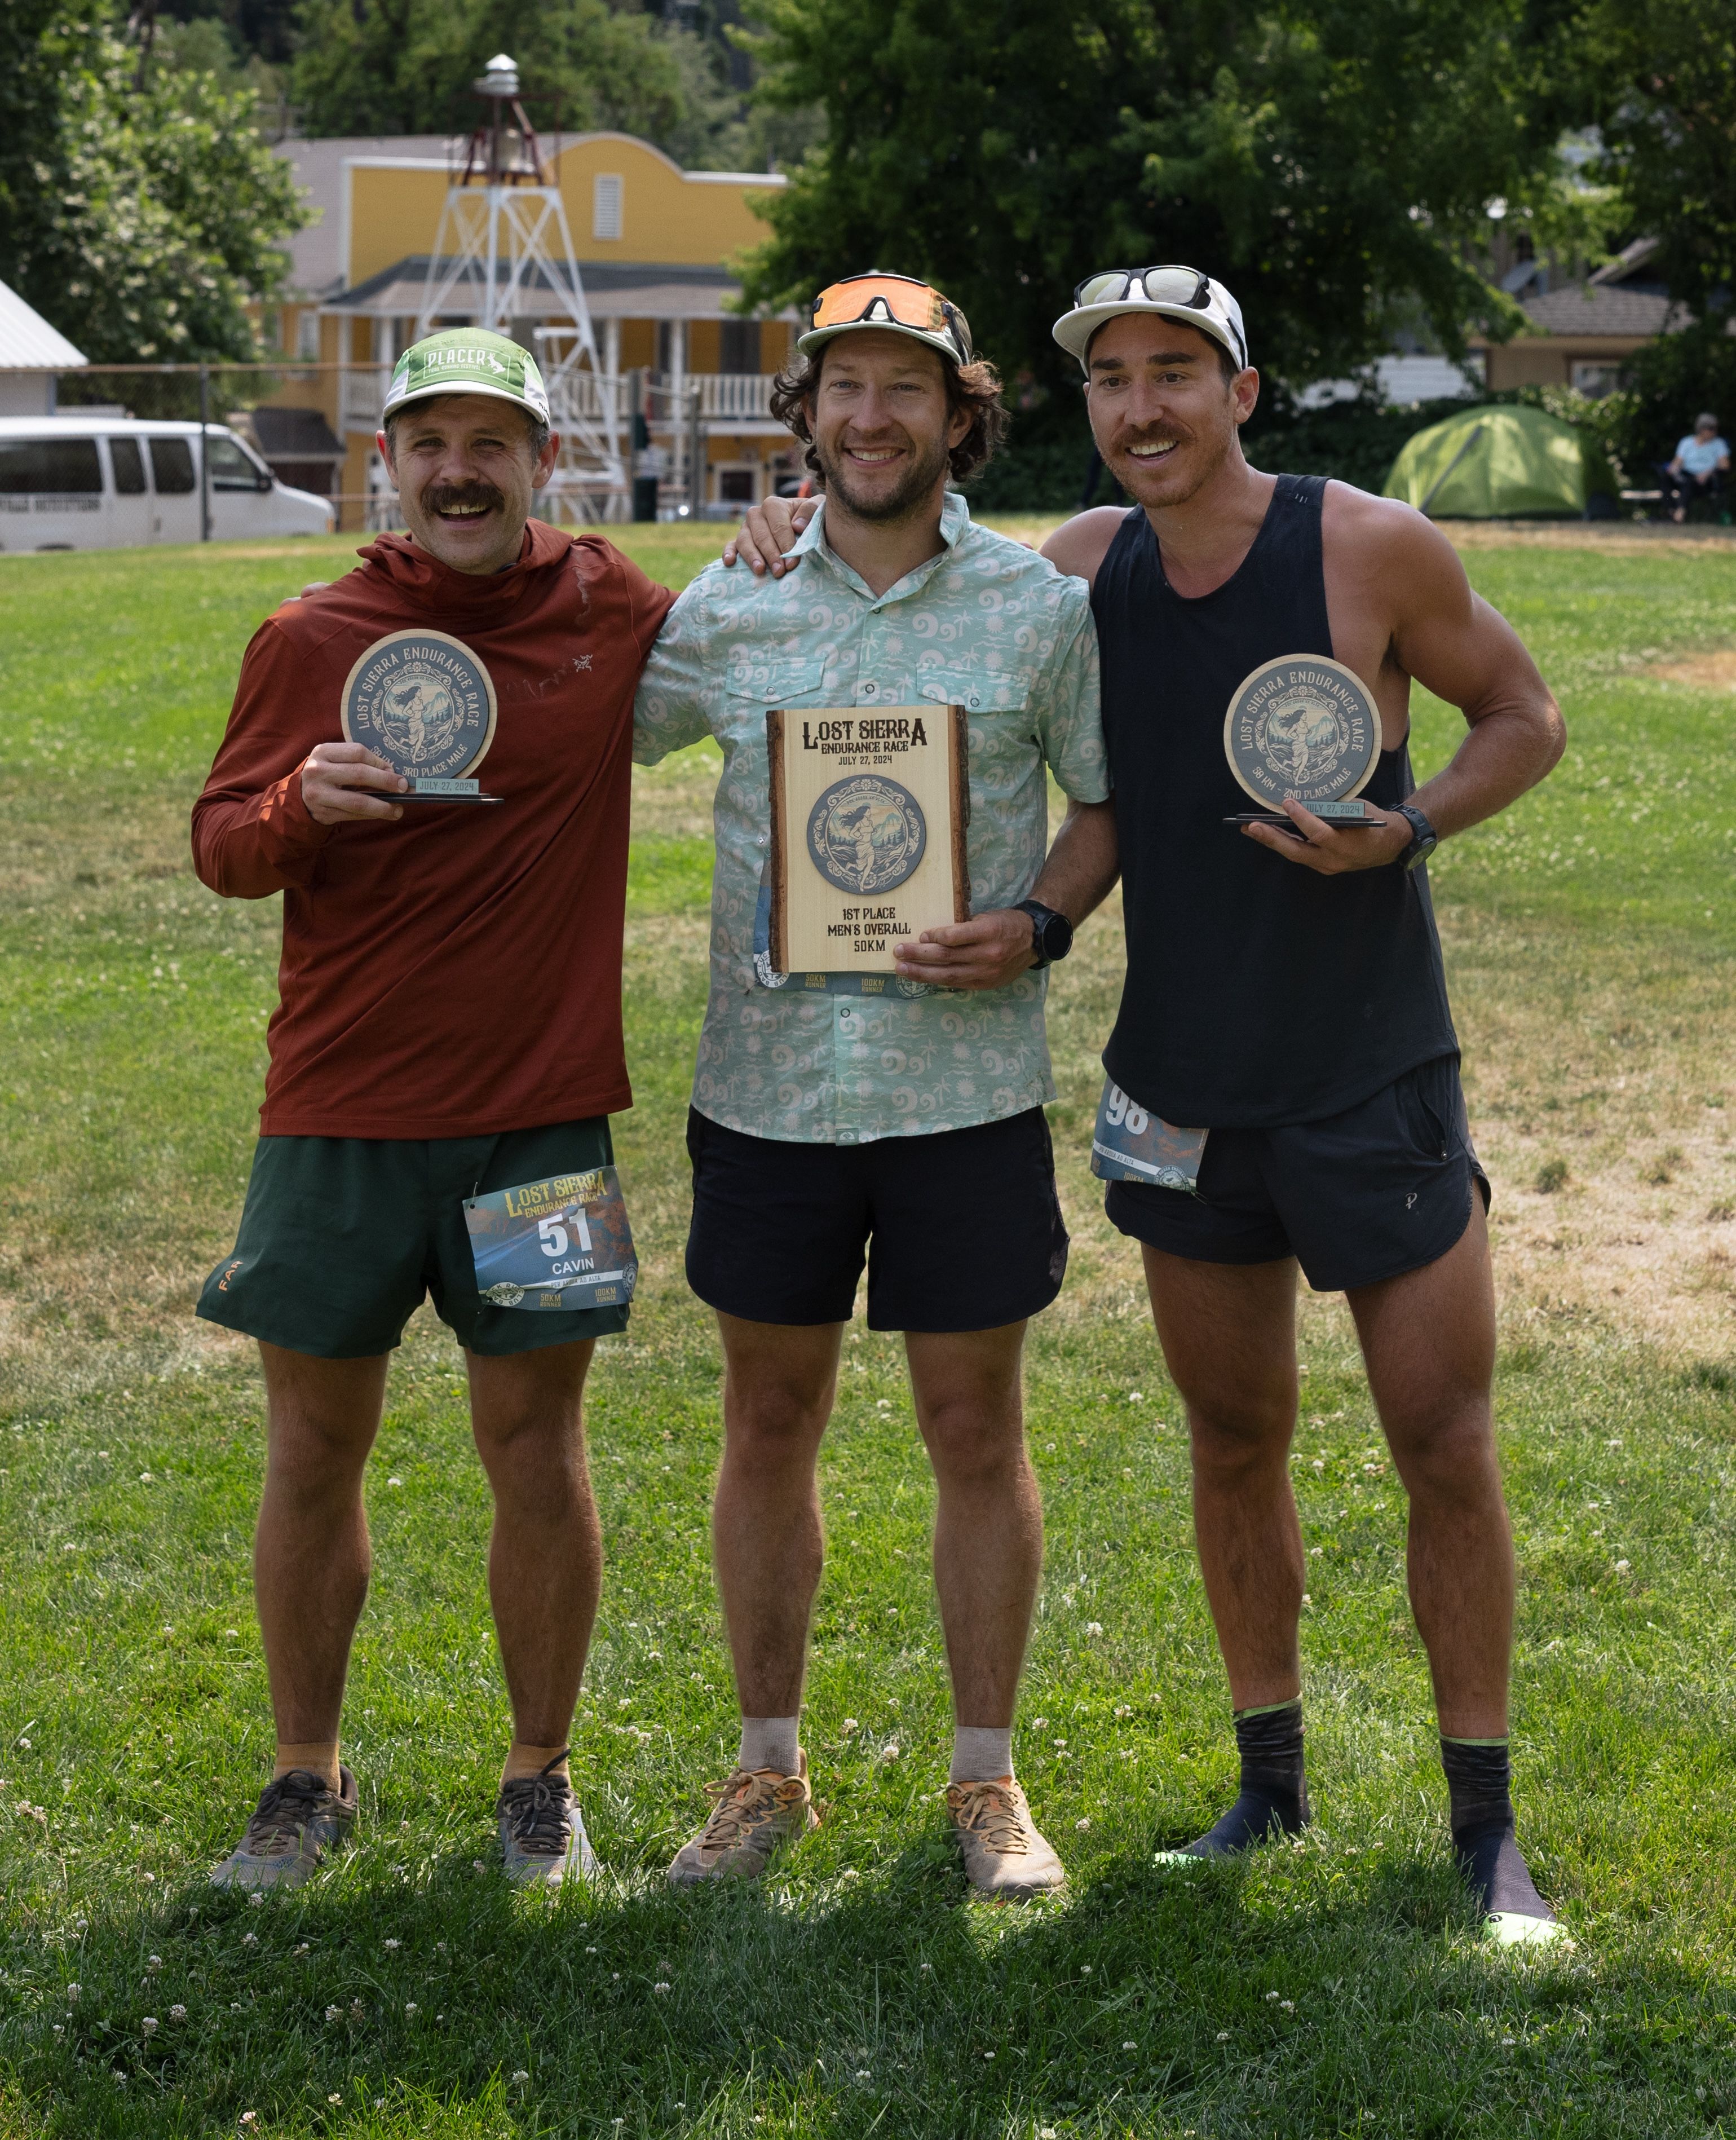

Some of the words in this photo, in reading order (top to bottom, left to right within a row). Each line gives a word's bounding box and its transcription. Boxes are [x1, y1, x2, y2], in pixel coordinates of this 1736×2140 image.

[427, 348, 486, 368] PLACER
[361, 653, 399, 692] SIERRA
[403, 647, 473, 689] ENDURANCE
[357, 695, 370, 729] LOST
[465, 691, 479, 727] RACE
[1240, 716, 1253, 750] LOST
[1247, 676, 1285, 713] SIERRA
[1289, 671, 1359, 714] ENDURANCE
[1351, 717, 1364, 752] RACE
[802, 720, 854, 749] LOST
[859, 718, 927, 746] SIERRA
[821, 741, 881, 754] ENDURANCE
[883, 740, 909, 752] RACE
[402, 766, 419, 777] 3RD
[421, 761, 448, 777] PLACE
[446, 743, 468, 766] MALE
[838, 756, 856, 765] JULY
[860, 756, 871, 766] 27,
[873, 754, 893, 764] 2024
[419, 782, 439, 790] JULY
[441, 782, 452, 791] 27,
[455, 782, 474, 791] 2024
[1261, 775, 1276, 791] KM
[1283, 788, 1301, 800] 2ND
[1304, 784, 1331, 800] PLACE
[1329, 767, 1352, 789] MALE
[1306, 804, 1324, 813] JULY
[1327, 805, 1337, 814] 27,
[1340, 805, 1360, 814] 2024
[842, 908, 860, 920] 1ST
[863, 907, 896, 920] PLACE
[828, 924, 860, 937] MEN'S
[864, 923, 911, 936] OVERALL
[854, 939, 886, 952] 50KM
[758, 970, 770, 986] BAD
[806, 974, 826, 982] 50KM
[862, 978, 885, 987] 100KM
[1106, 1084, 1149, 1135] 98
[505, 1182, 550, 1218] LOST
[553, 1171, 608, 1197] SIERRA
[524, 1195, 577, 1219] ENDURANCE
[578, 1192, 598, 1204] RACE
[538, 1207, 593, 1257] 51
[552, 1257, 595, 1275] CAVIN
[540, 1293, 561, 1302] 50KM
[595, 1286, 617, 1296] 100KM
[596, 1295, 617, 1303] RUNNER
